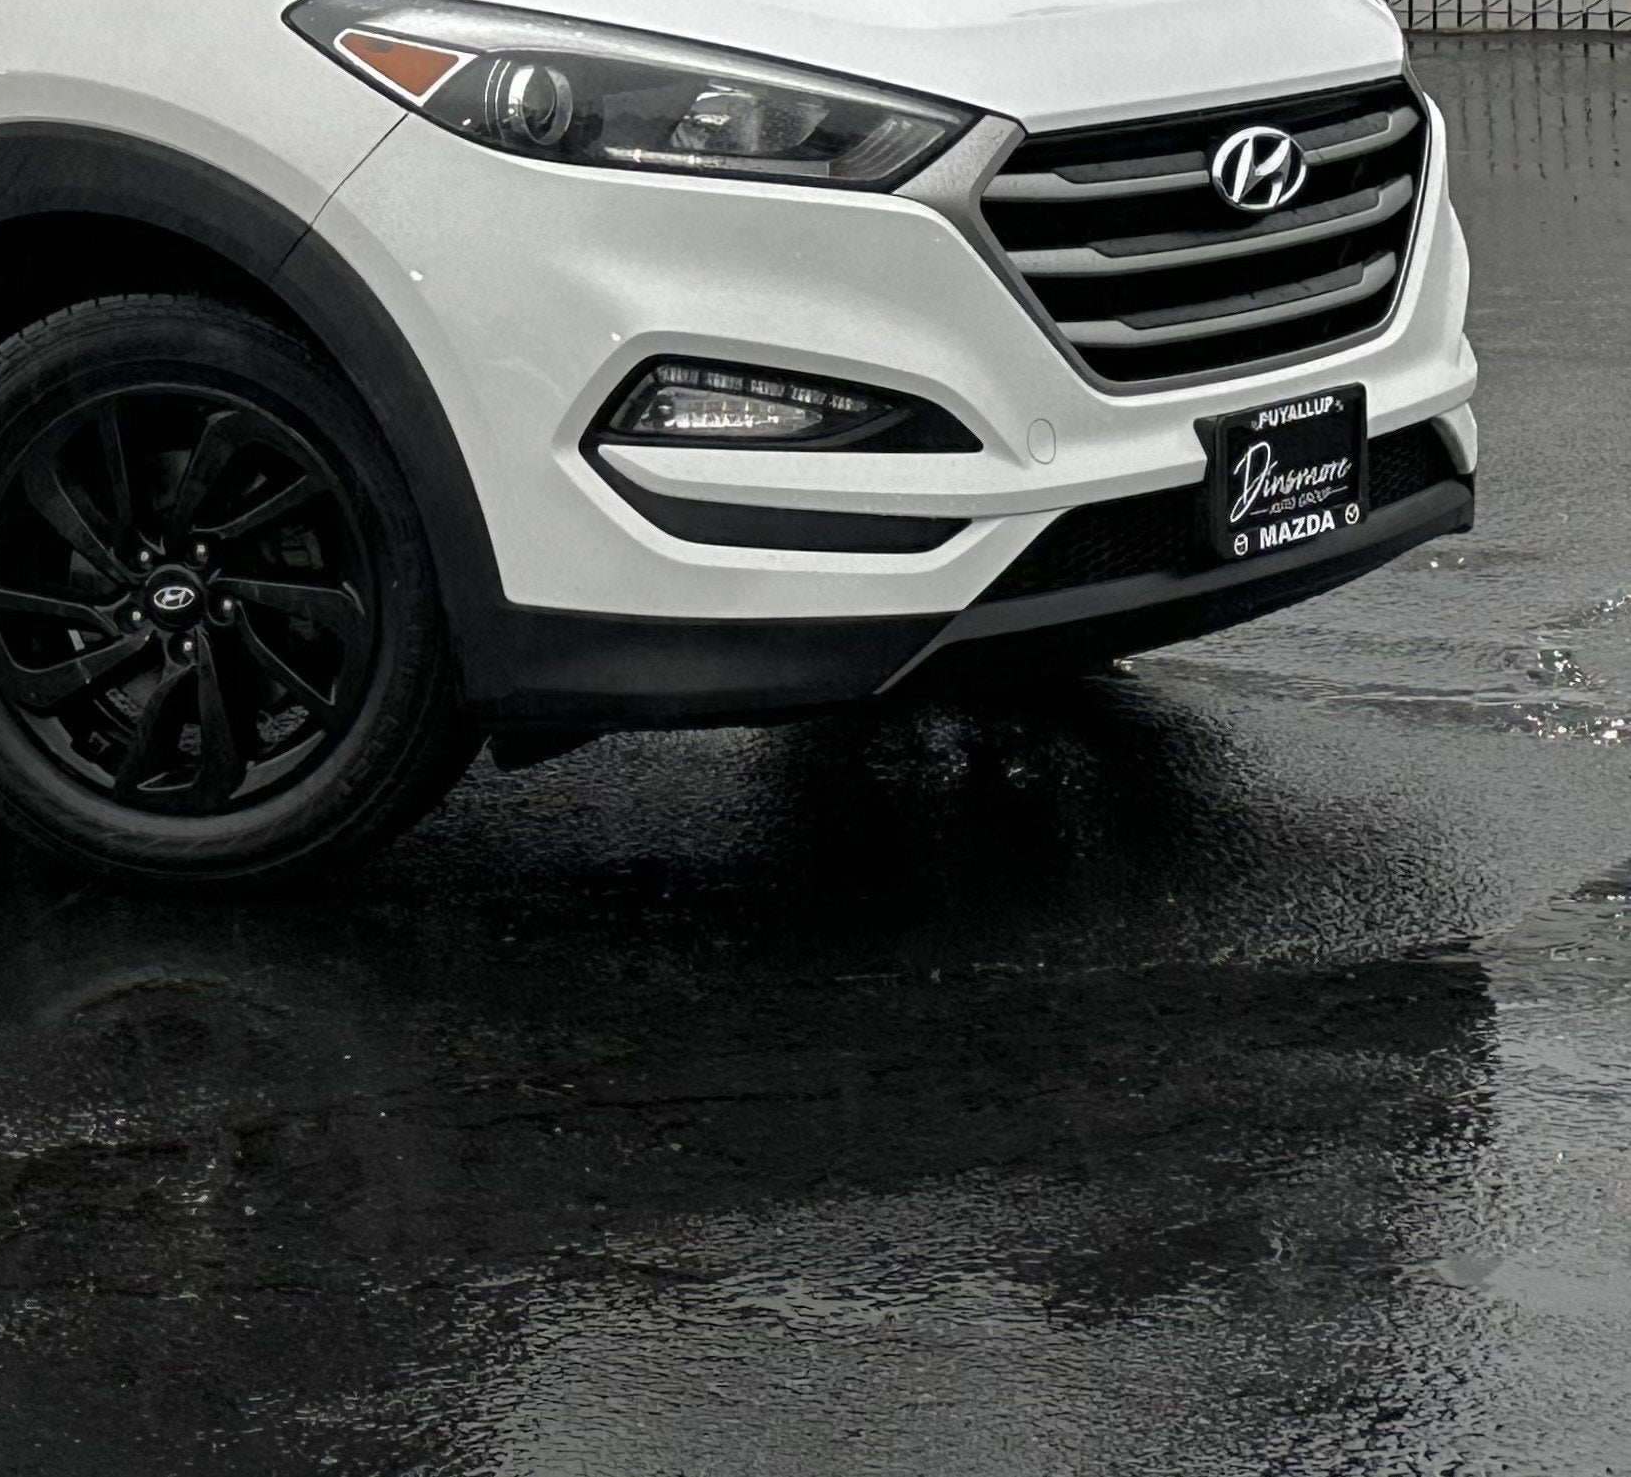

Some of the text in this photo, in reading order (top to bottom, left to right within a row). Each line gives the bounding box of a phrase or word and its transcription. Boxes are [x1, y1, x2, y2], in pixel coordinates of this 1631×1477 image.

[1257, 396, 1334, 429] PUYALLUP
[1230, 441, 1353, 523] Dinsmore
[1259, 509, 1336, 550] MAZDA
